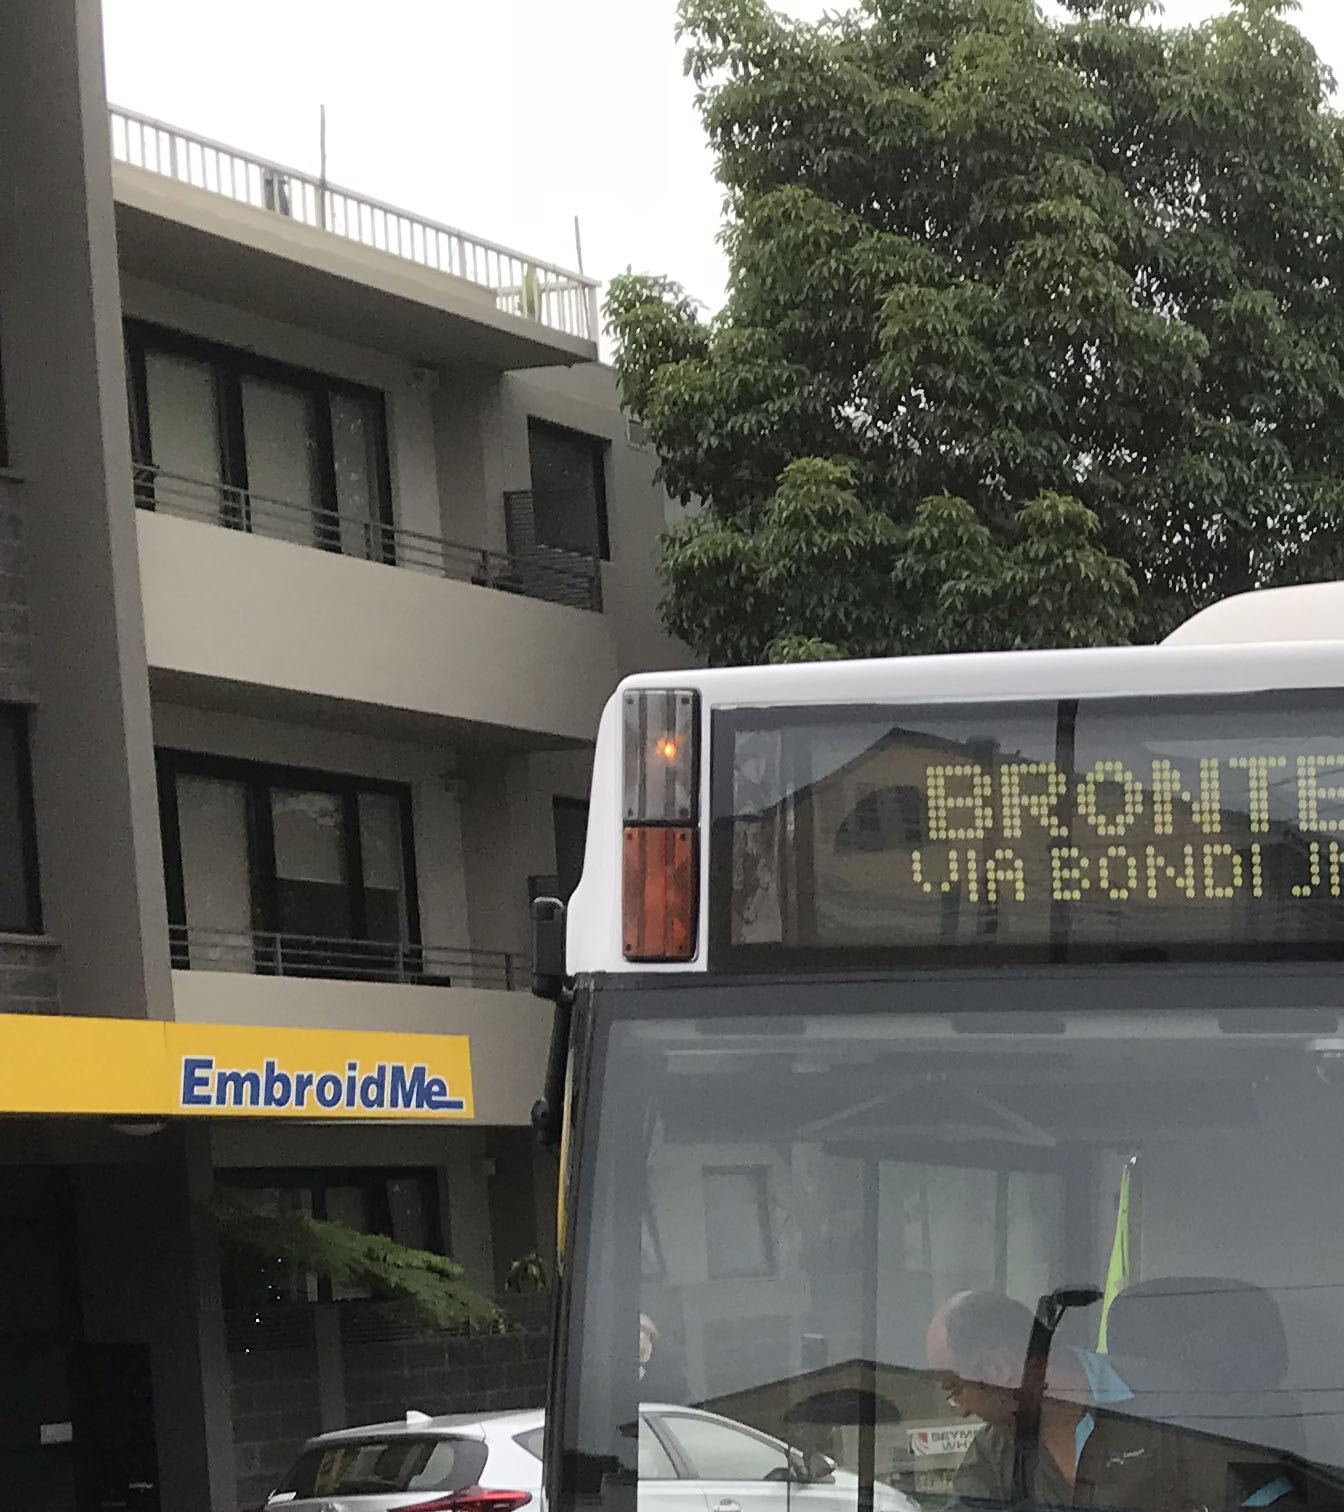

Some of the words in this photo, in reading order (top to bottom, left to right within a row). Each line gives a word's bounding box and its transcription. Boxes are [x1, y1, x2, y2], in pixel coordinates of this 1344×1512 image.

[912, 848, 1025, 901] VIA
[1051, 842, 1263, 901] BONDI
[181, 1057, 465, 1111] EmbroidMe
